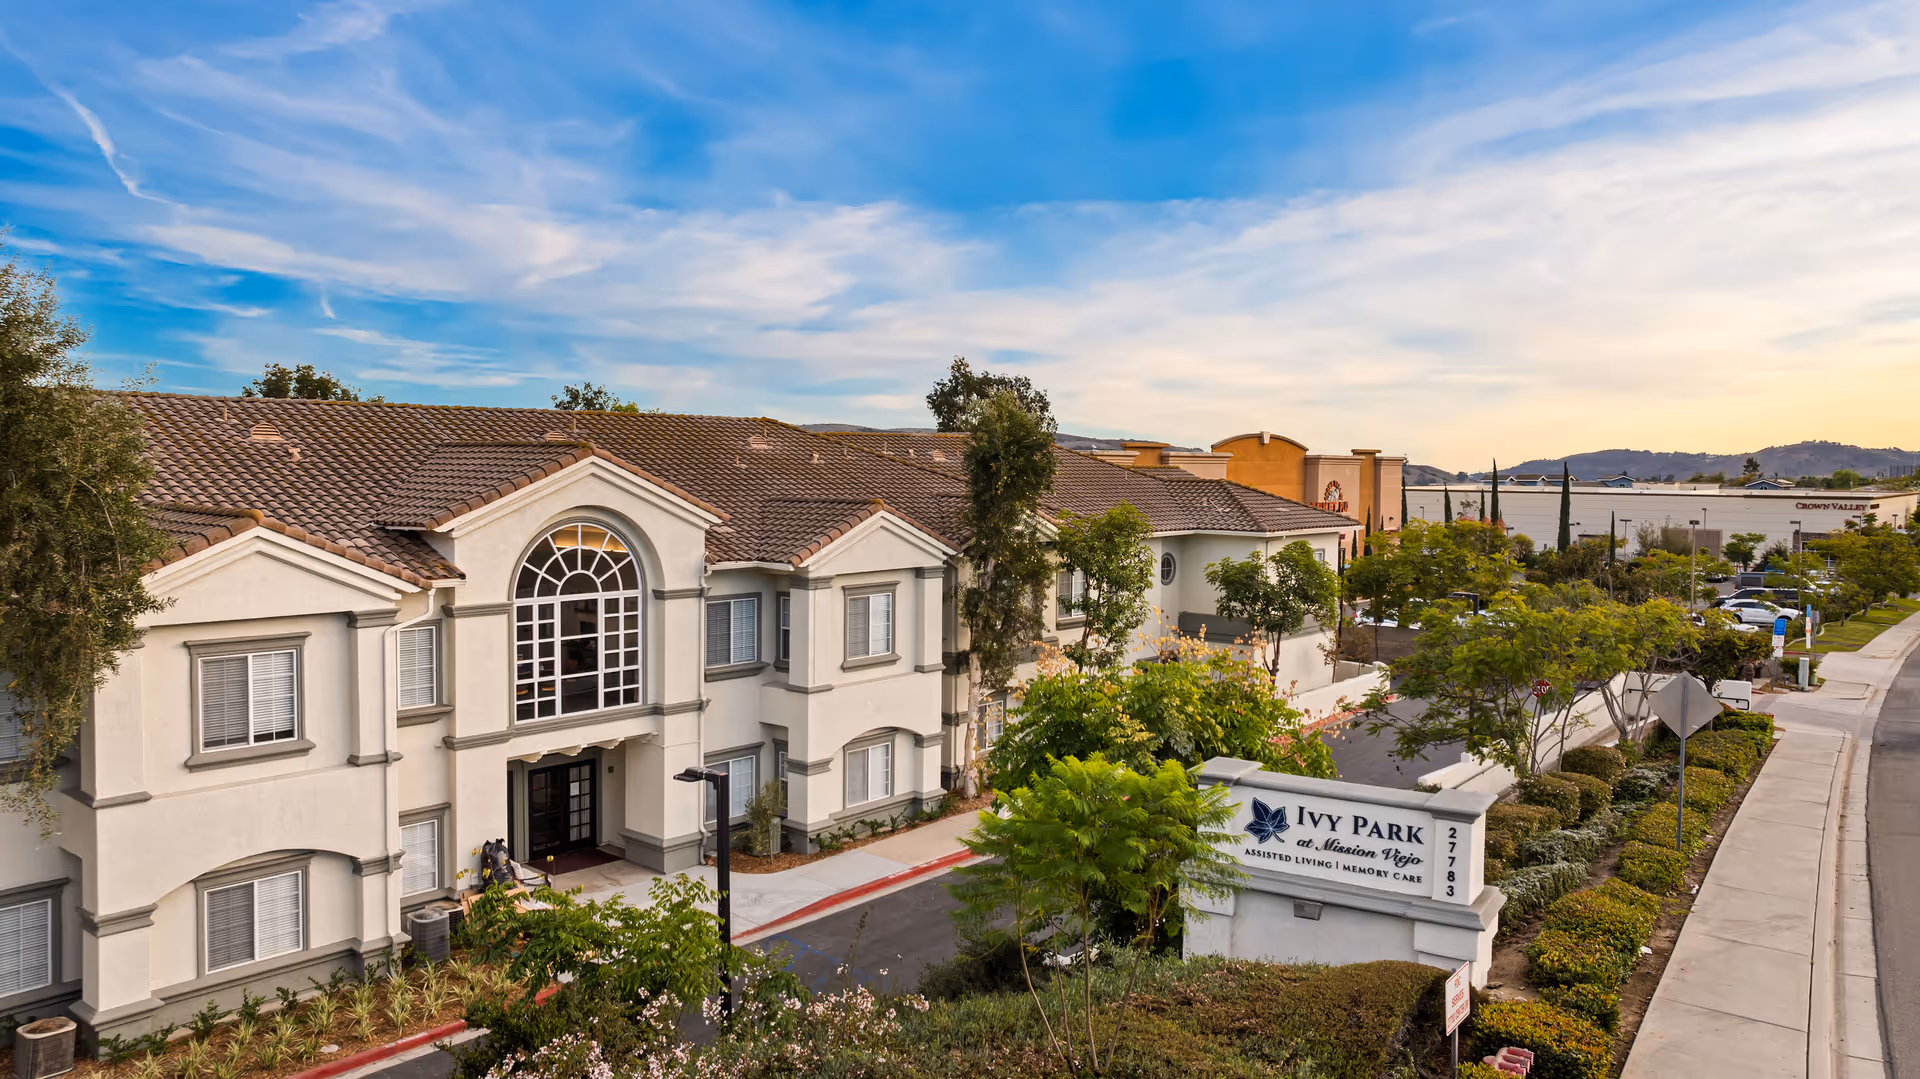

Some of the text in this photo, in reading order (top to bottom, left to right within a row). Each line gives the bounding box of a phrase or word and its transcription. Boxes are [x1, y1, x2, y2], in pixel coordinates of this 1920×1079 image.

[1796, 502, 1830, 510] CROWN
[1297, 806, 1424, 845] IVY PARK
[1245, 848, 1423, 883] ASSISTED LIVING MEMORY CARE
[1296, 837, 1424, 868] at Mission Viejo
[1446, 827, 1457, 897] 27783
